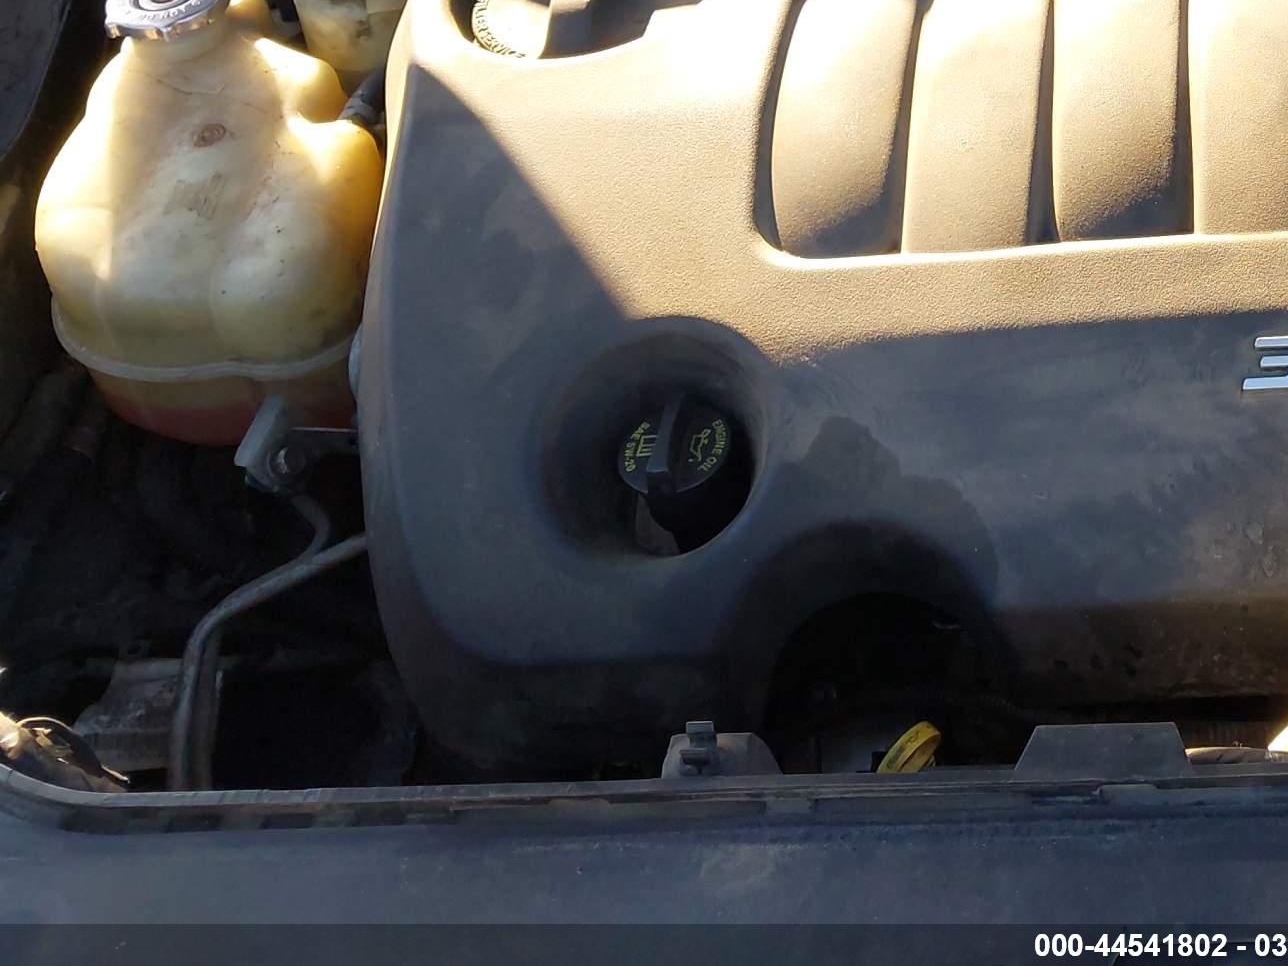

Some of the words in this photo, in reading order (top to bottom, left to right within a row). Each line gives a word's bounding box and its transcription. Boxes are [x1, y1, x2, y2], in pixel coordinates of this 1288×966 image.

[711, 418, 727, 455] ENGINE
[624, 442, 637, 473] 5W-20
[697, 455, 719, 472] OIL
